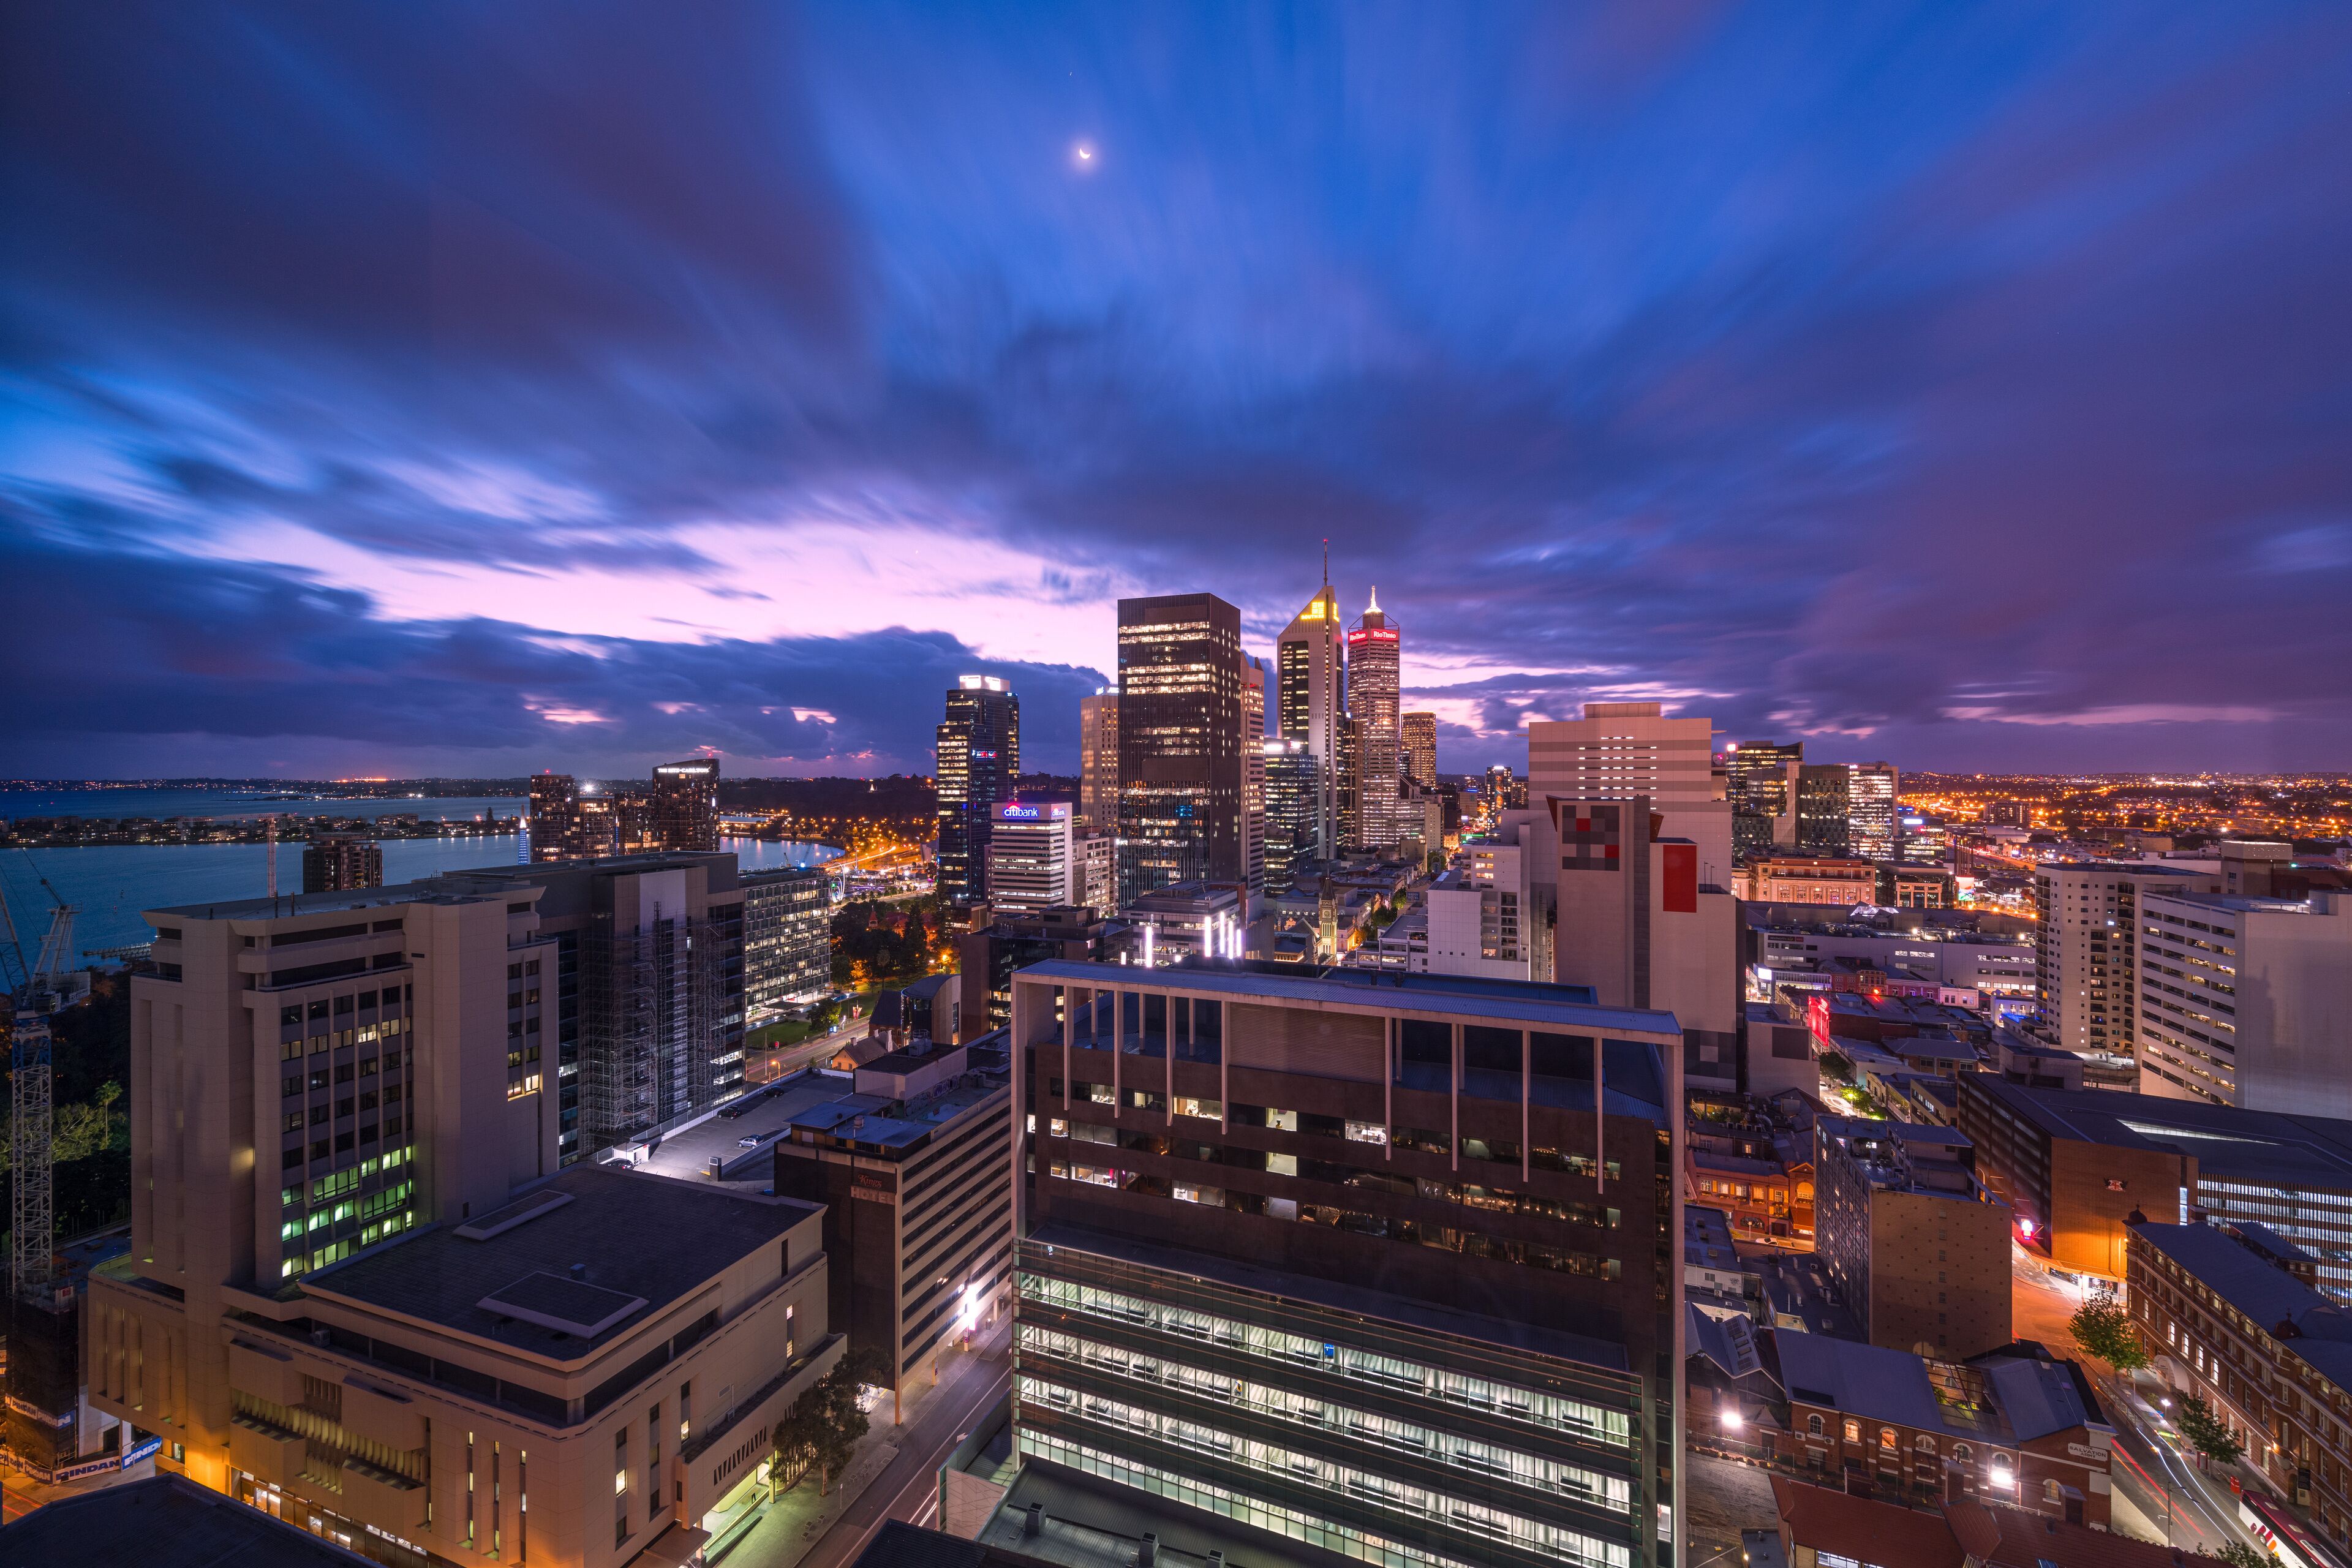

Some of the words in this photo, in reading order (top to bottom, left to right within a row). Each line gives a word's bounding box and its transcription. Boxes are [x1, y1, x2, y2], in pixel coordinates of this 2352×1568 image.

[1004, 805, 1038, 817] citibank
[858, 1174, 882, 1188] Kings
[124, 1441, 162, 1466] PIND
[2069, 1446, 2106, 1458] SALVATION
